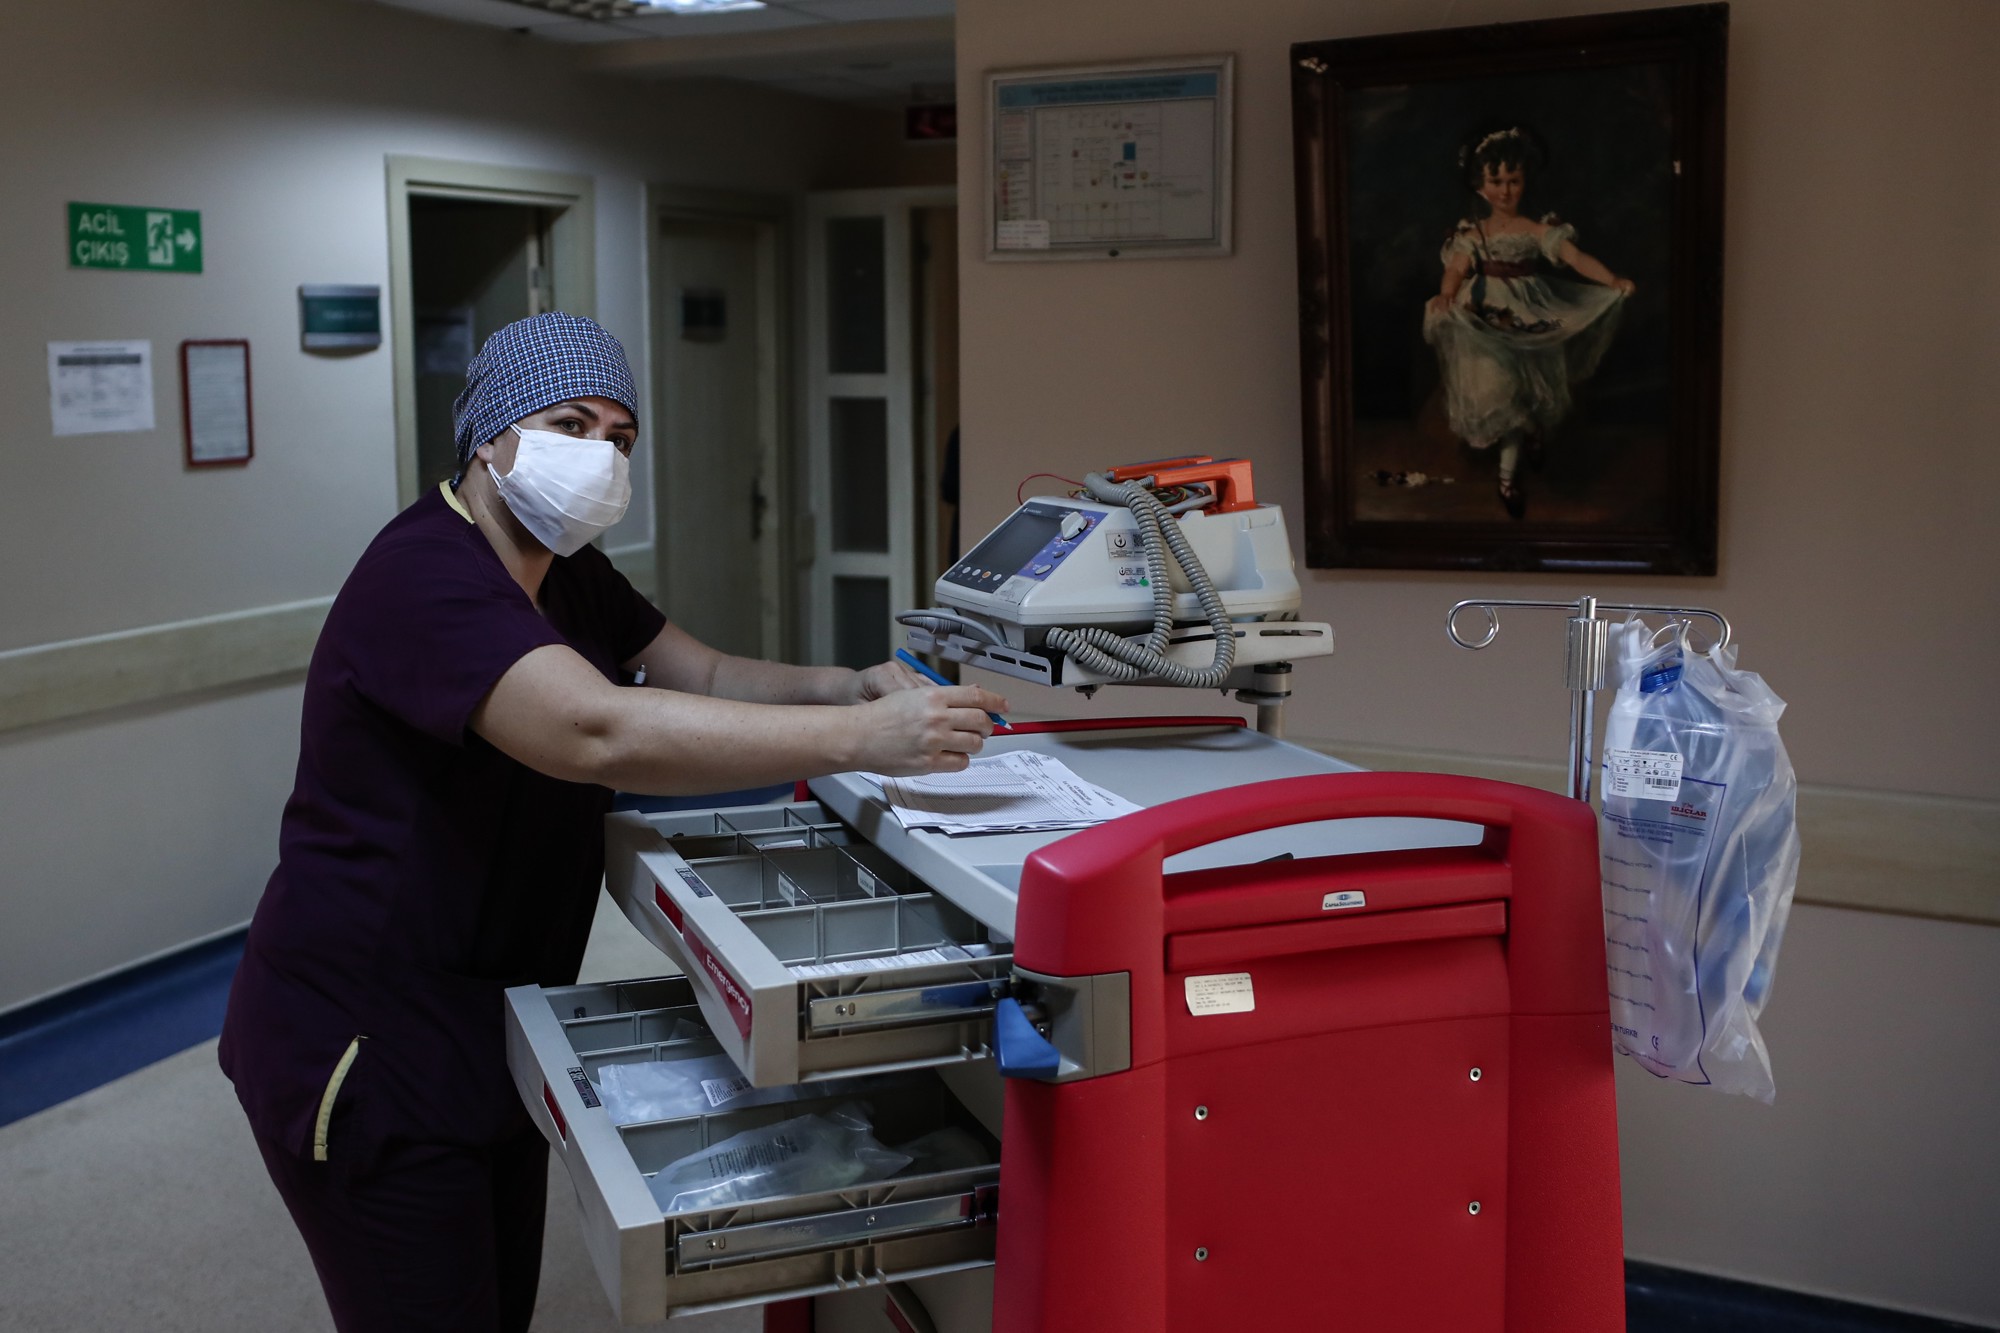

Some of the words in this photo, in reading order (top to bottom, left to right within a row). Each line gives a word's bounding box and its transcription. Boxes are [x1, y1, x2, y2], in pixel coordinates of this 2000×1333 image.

[78, 209, 125, 235] ACİL
[76, 239, 129, 266] ÇIKIŞ
[706, 954, 750, 1016] Emergency
